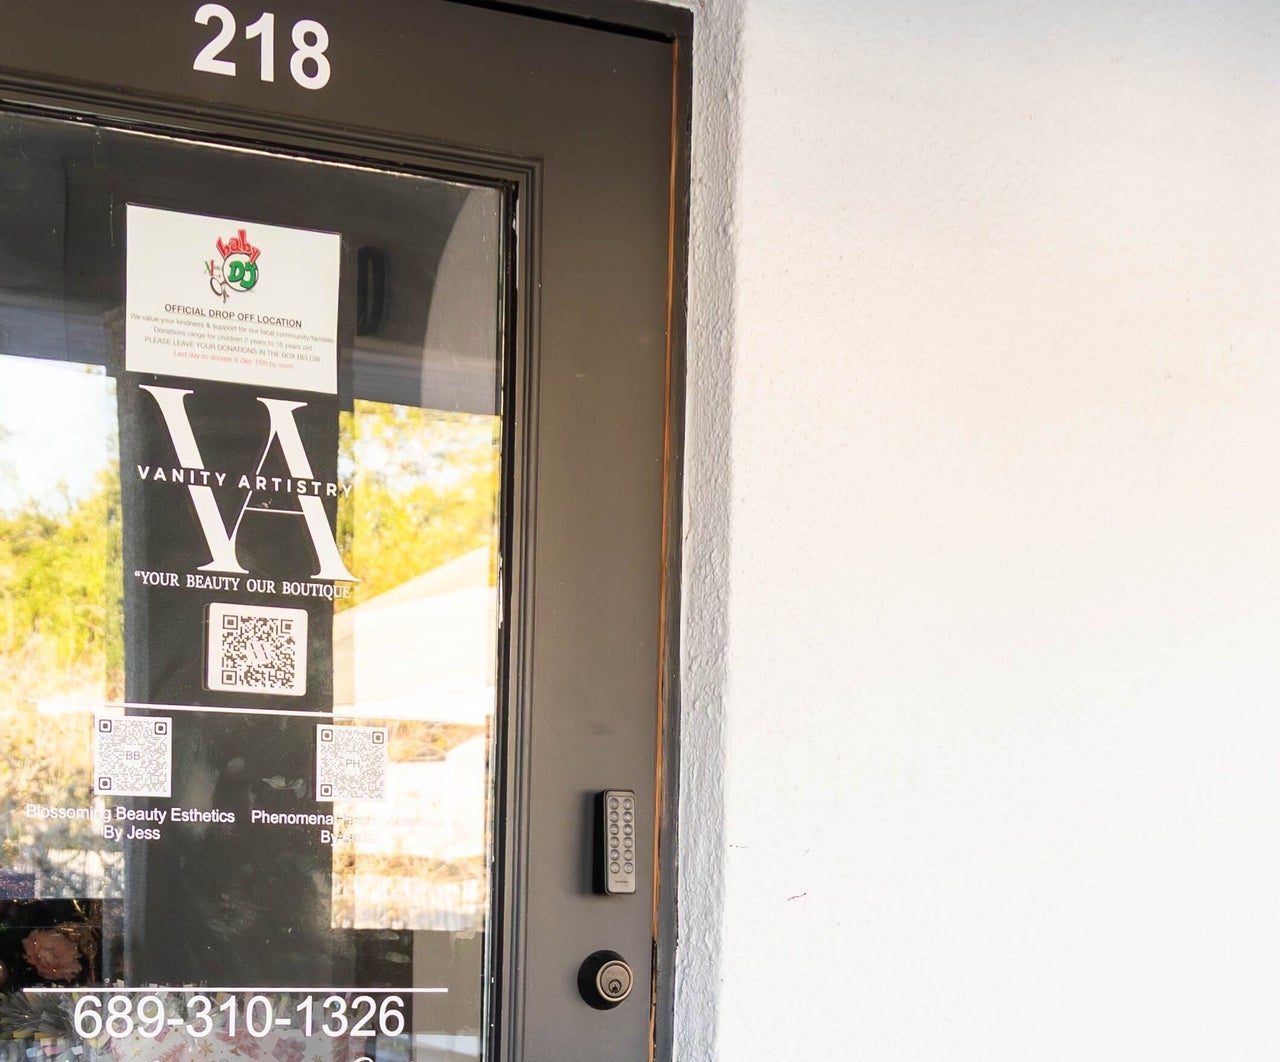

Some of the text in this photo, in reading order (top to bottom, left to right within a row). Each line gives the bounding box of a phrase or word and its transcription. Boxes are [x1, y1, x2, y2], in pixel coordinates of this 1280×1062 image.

[193, 3, 331, 90] 218
[216, 229, 261, 264] baby
[228, 260, 257, 290] DJ
[142, 314, 159, 322] value
[160, 317, 174, 325] your
[176, 318, 205, 328] kindness
[164, 303, 303, 329] OFFICIAL DROP OFF LOCATION
[153, 326, 186, 337] Donations
[187, 332, 206, 341] range
[217, 334, 243, 343] children
[144, 335, 172, 346] PLEASE
[172, 339, 195, 349] LEAVE
[196, 342, 216, 351] YOUR
[217, 344, 257, 356] DONATIONS
[267, 350, 280, 358] THE
[281, 352, 295, 361] BOX
[297, 354, 321, 363] BELOW
[173, 350, 187, 359] Last
[188, 352, 201, 361] day
[137, 465, 353, 498] VANITY ARTISTRY
[138, 384, 361, 583] VA
[186, 574, 240, 591] BEAUTY
[246, 578, 276, 593] OUR
[282, 582, 351, 601] BOUTIQUE
[125, 751, 141, 761] BB
[346, 759, 360, 769] PH
[115, 806, 167, 825] Beauty
[170, 808, 236, 823] Esthetics
[103, 825, 161, 842] By Jess
[74, 994, 406, 1039] 689-310-1326
